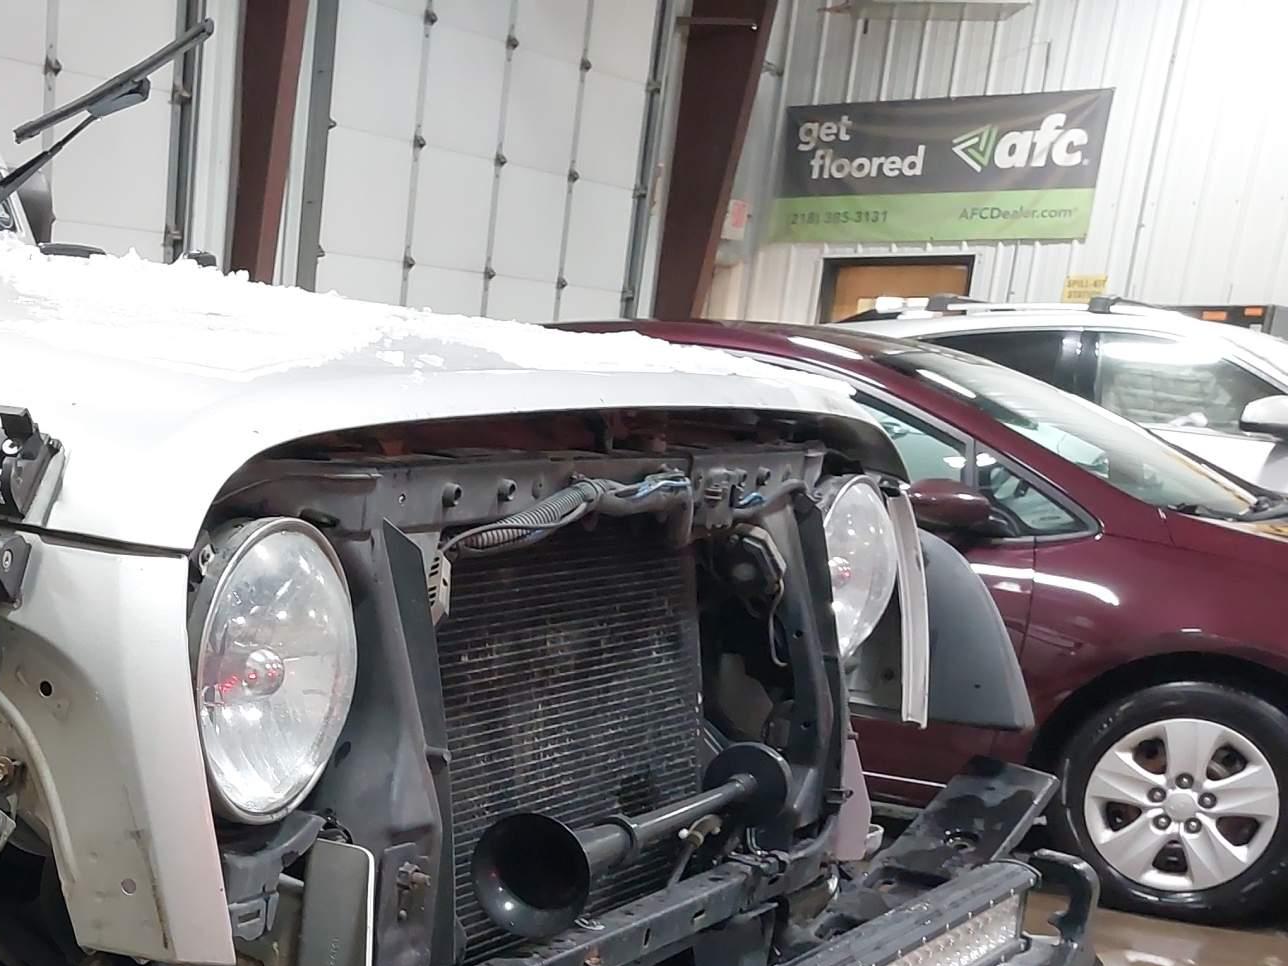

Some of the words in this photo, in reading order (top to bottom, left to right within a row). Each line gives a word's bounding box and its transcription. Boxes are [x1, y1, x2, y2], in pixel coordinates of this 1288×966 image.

[797, 115, 853, 150] get
[994, 112, 1089, 169] afc
[810, 144, 927, 180] floored
[959, 206, 1073, 220] AFCDealer.com
